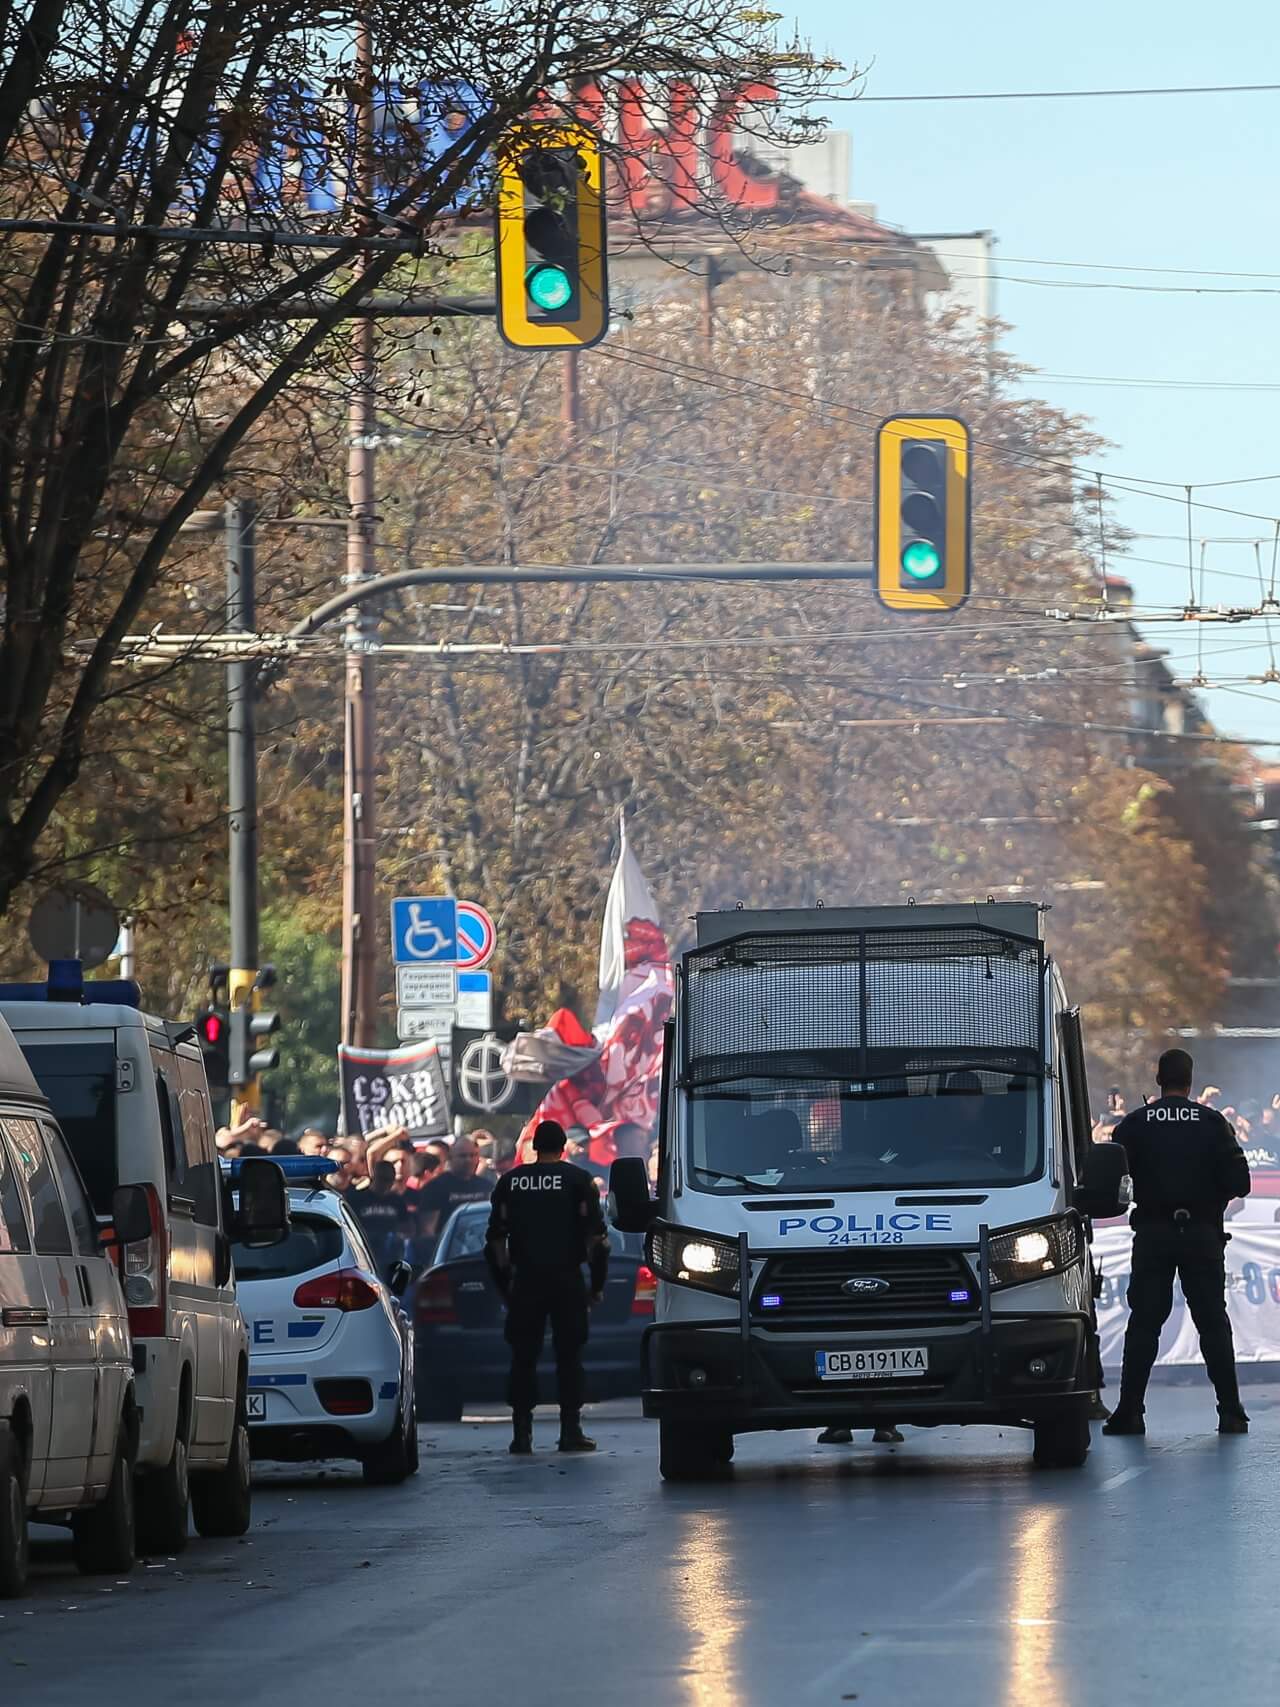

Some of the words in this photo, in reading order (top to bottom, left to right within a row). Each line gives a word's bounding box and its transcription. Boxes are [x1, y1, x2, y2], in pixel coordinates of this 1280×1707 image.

[1146, 1107, 1200, 1122] POLICE
[511, 1175, 562, 1191] POLICE
[779, 1213, 953, 1236] POLICE
[828, 1231, 904, 1246] 24-1128
[828, 1354, 852, 1371] CB
[855, 1351, 897, 1370] 8191
[901, 1350, 925, 1368] KA
